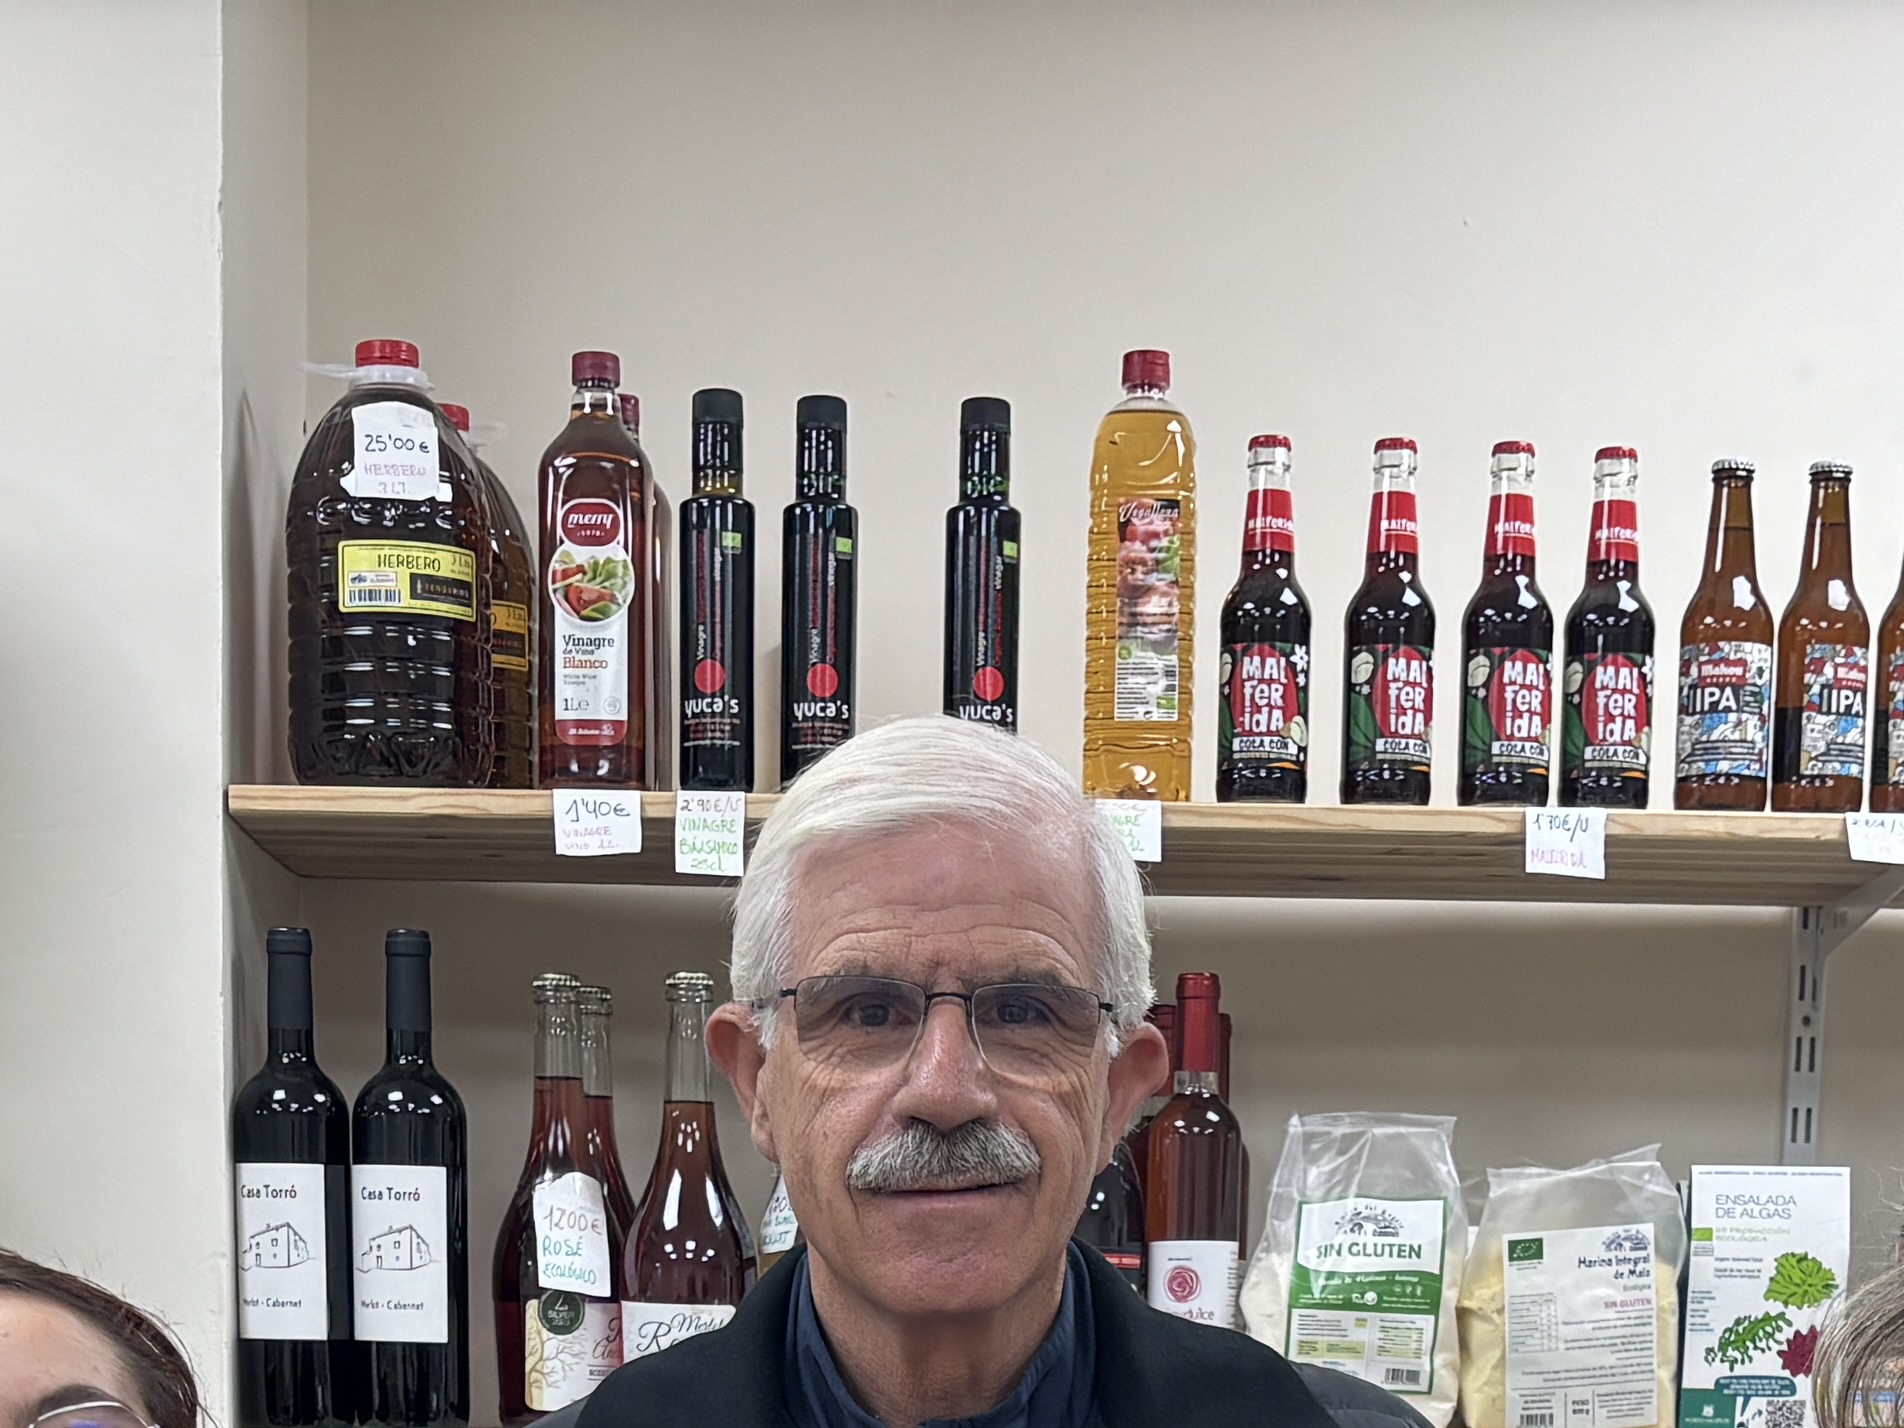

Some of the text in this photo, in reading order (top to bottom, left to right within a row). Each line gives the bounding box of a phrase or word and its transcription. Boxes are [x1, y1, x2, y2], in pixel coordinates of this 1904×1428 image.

[377, 553, 441, 573] HERBERO
[562, 634, 615, 650] Vinagre
[562, 657, 608, 669] Blanco
[1242, 655, 1288, 683] MAL
[1387, 657, 1427, 685] MAL
[1503, 659, 1546, 688] MAL
[1595, 665, 1640, 694] MAL
[240, 1183, 298, 1200] Casa Torró
[360, 1185, 421, 1202] Casa Torró
[1715, 1194, 1797, 1207] ENSALADA
[1715, 1207, 1792, 1220] DE ALGAS
[1316, 1243, 1422, 1261] SIN GLUTEN
[1578, 1253, 1651, 1268] Harina Integral
[1614, 1270, 1625, 1280] de
